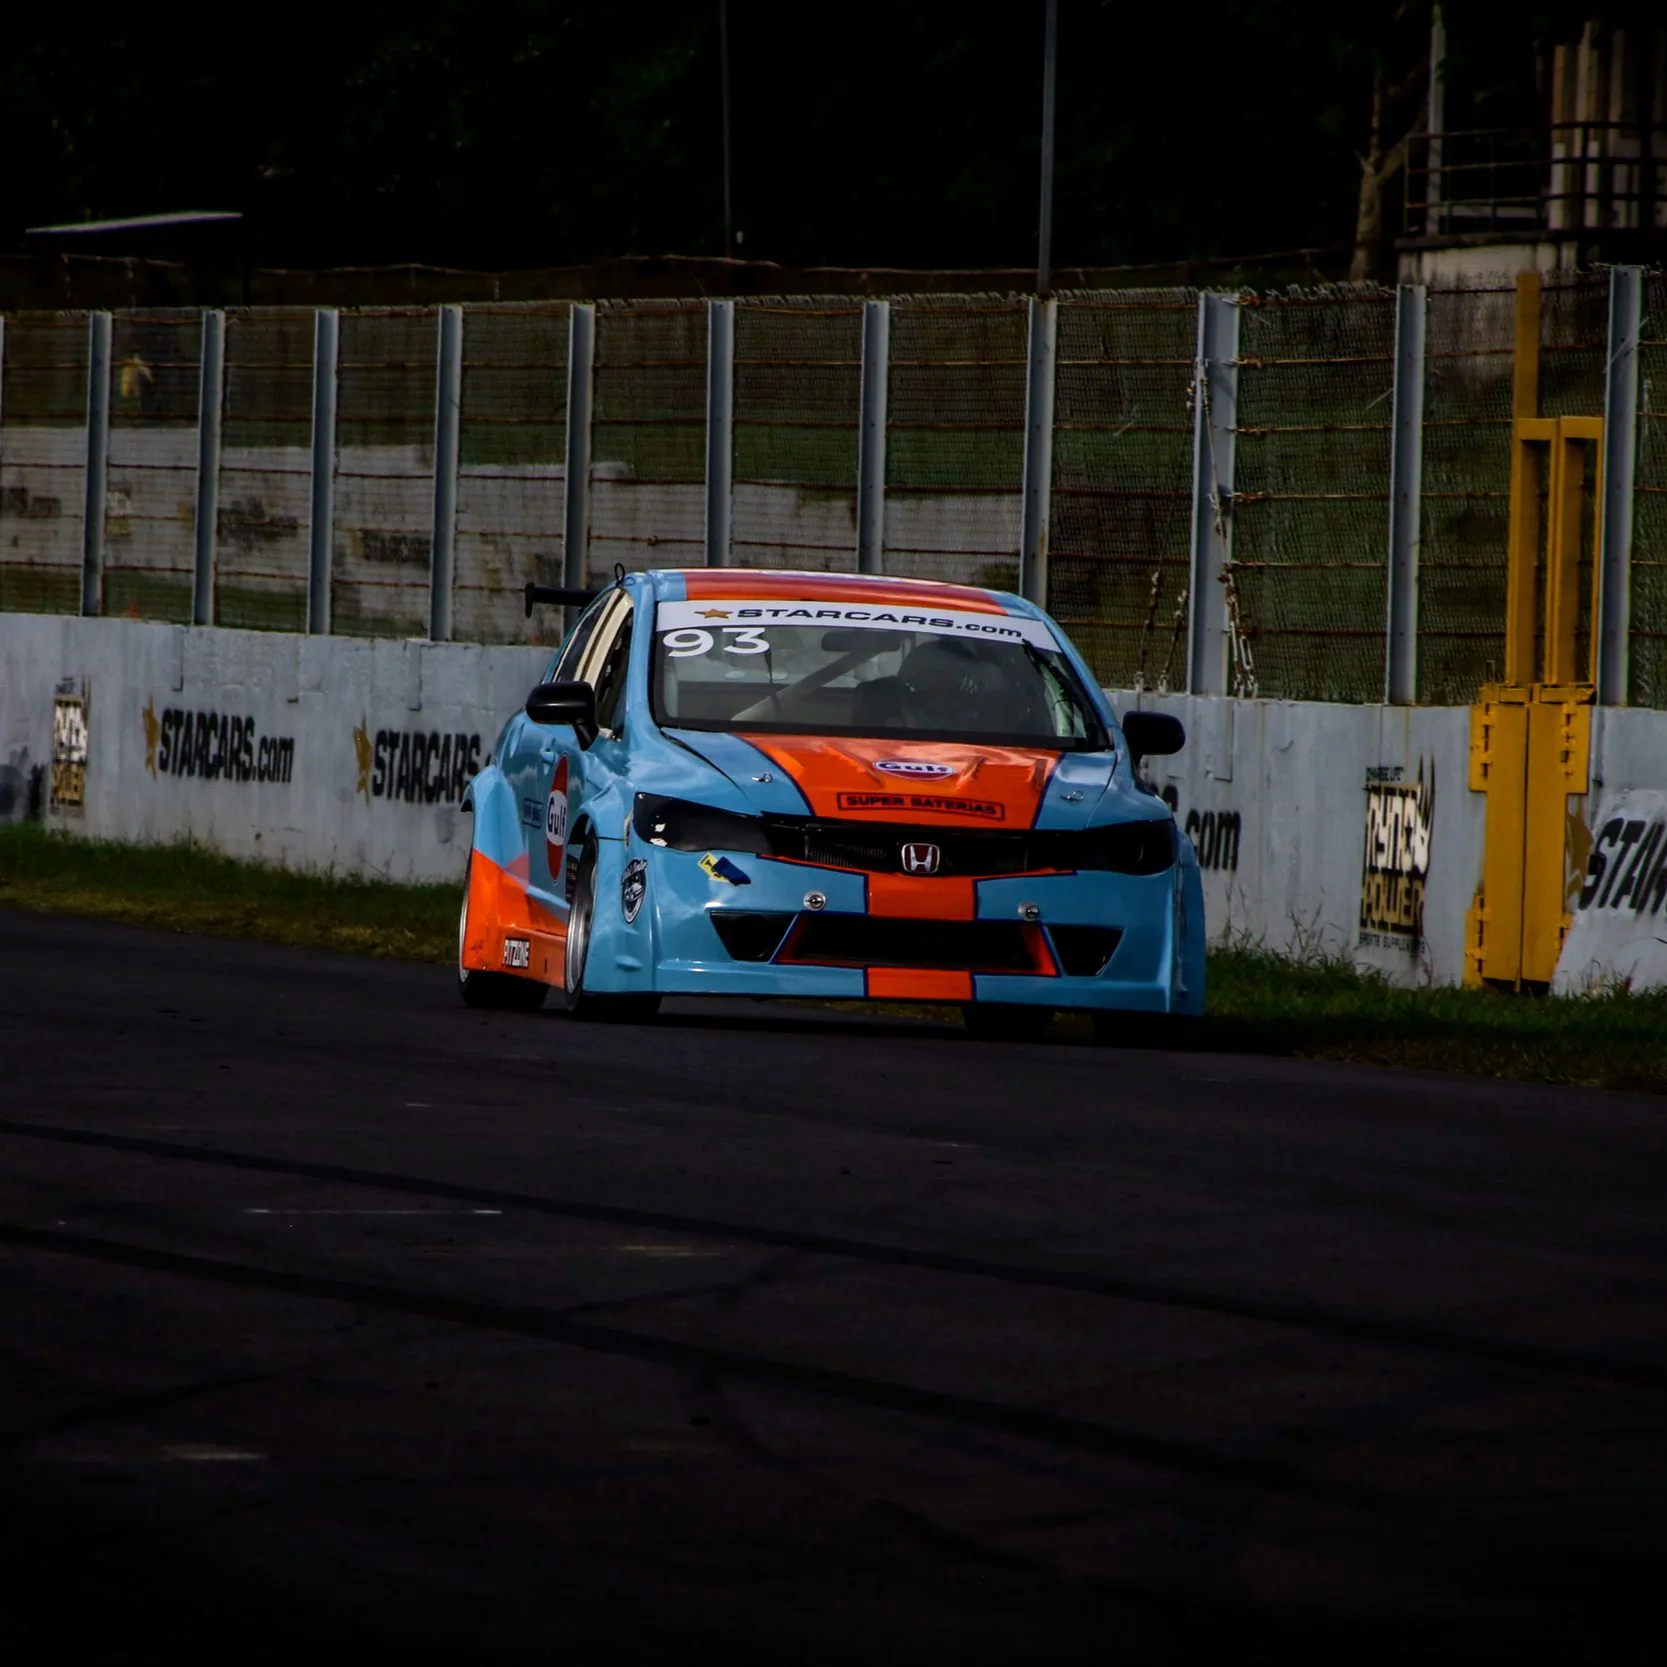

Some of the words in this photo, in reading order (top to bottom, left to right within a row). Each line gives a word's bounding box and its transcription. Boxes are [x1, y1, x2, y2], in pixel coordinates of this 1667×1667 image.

[736, 607, 1023, 638] STARCARS.com
[662, 626, 771, 658] 93
[158, 707, 295, 783] STARCARS.com
[372, 729, 491, 804] STARCARS
[878, 761, 949, 773] Gulf
[547, 796, 567, 835] Gulf
[846, 795, 905, 807] SUPER
[910, 796, 998, 816] BATERIAS
[1578, 817, 1667, 915] STAR
